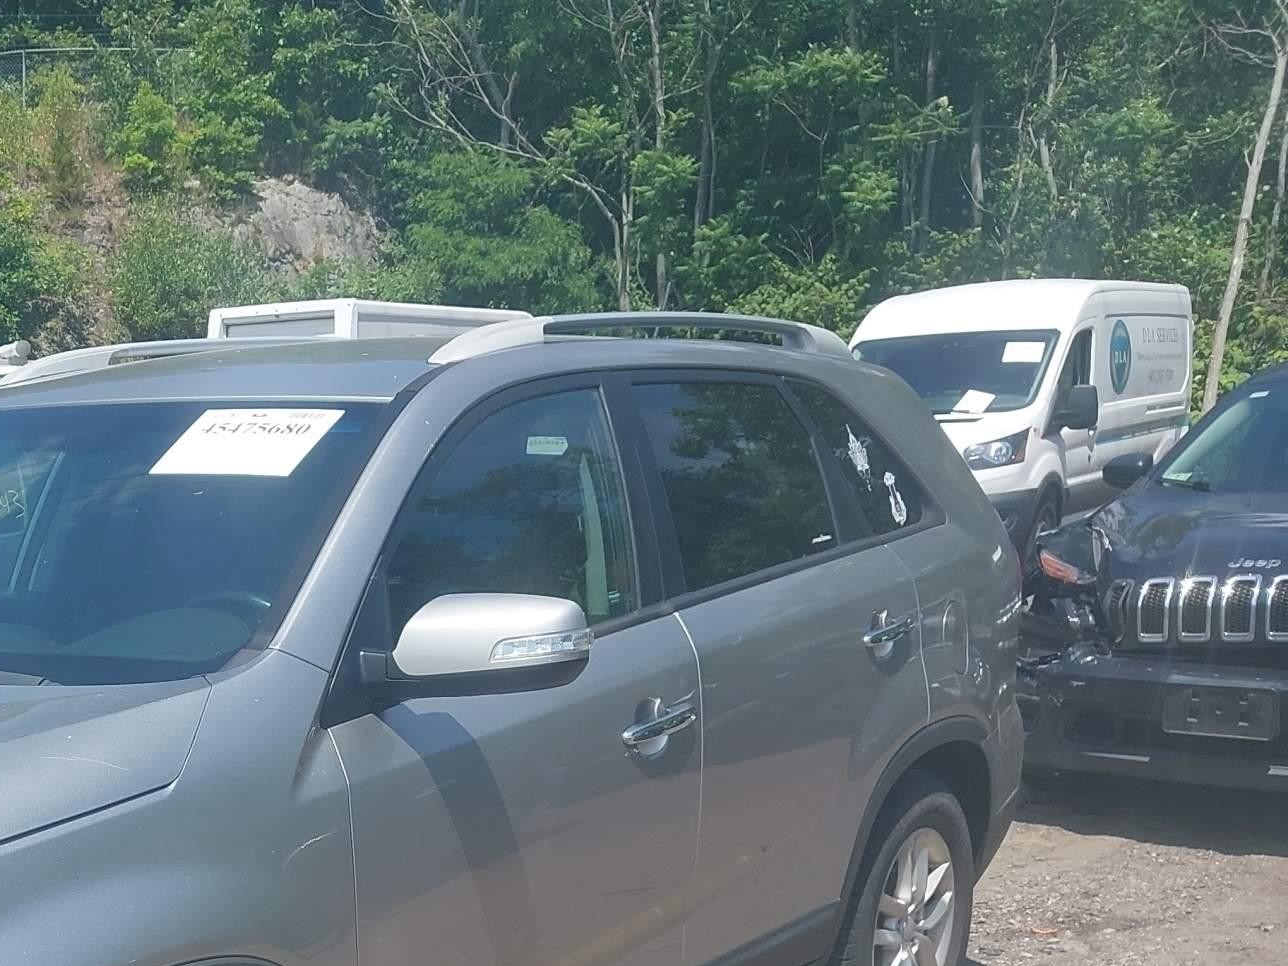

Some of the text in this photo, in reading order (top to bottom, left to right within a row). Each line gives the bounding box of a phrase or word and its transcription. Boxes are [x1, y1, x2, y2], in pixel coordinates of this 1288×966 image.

[1114, 351, 1127, 364] DLA
[203, 422, 312, 435] 45475680
[1227, 557, 1282, 569] Jeep
